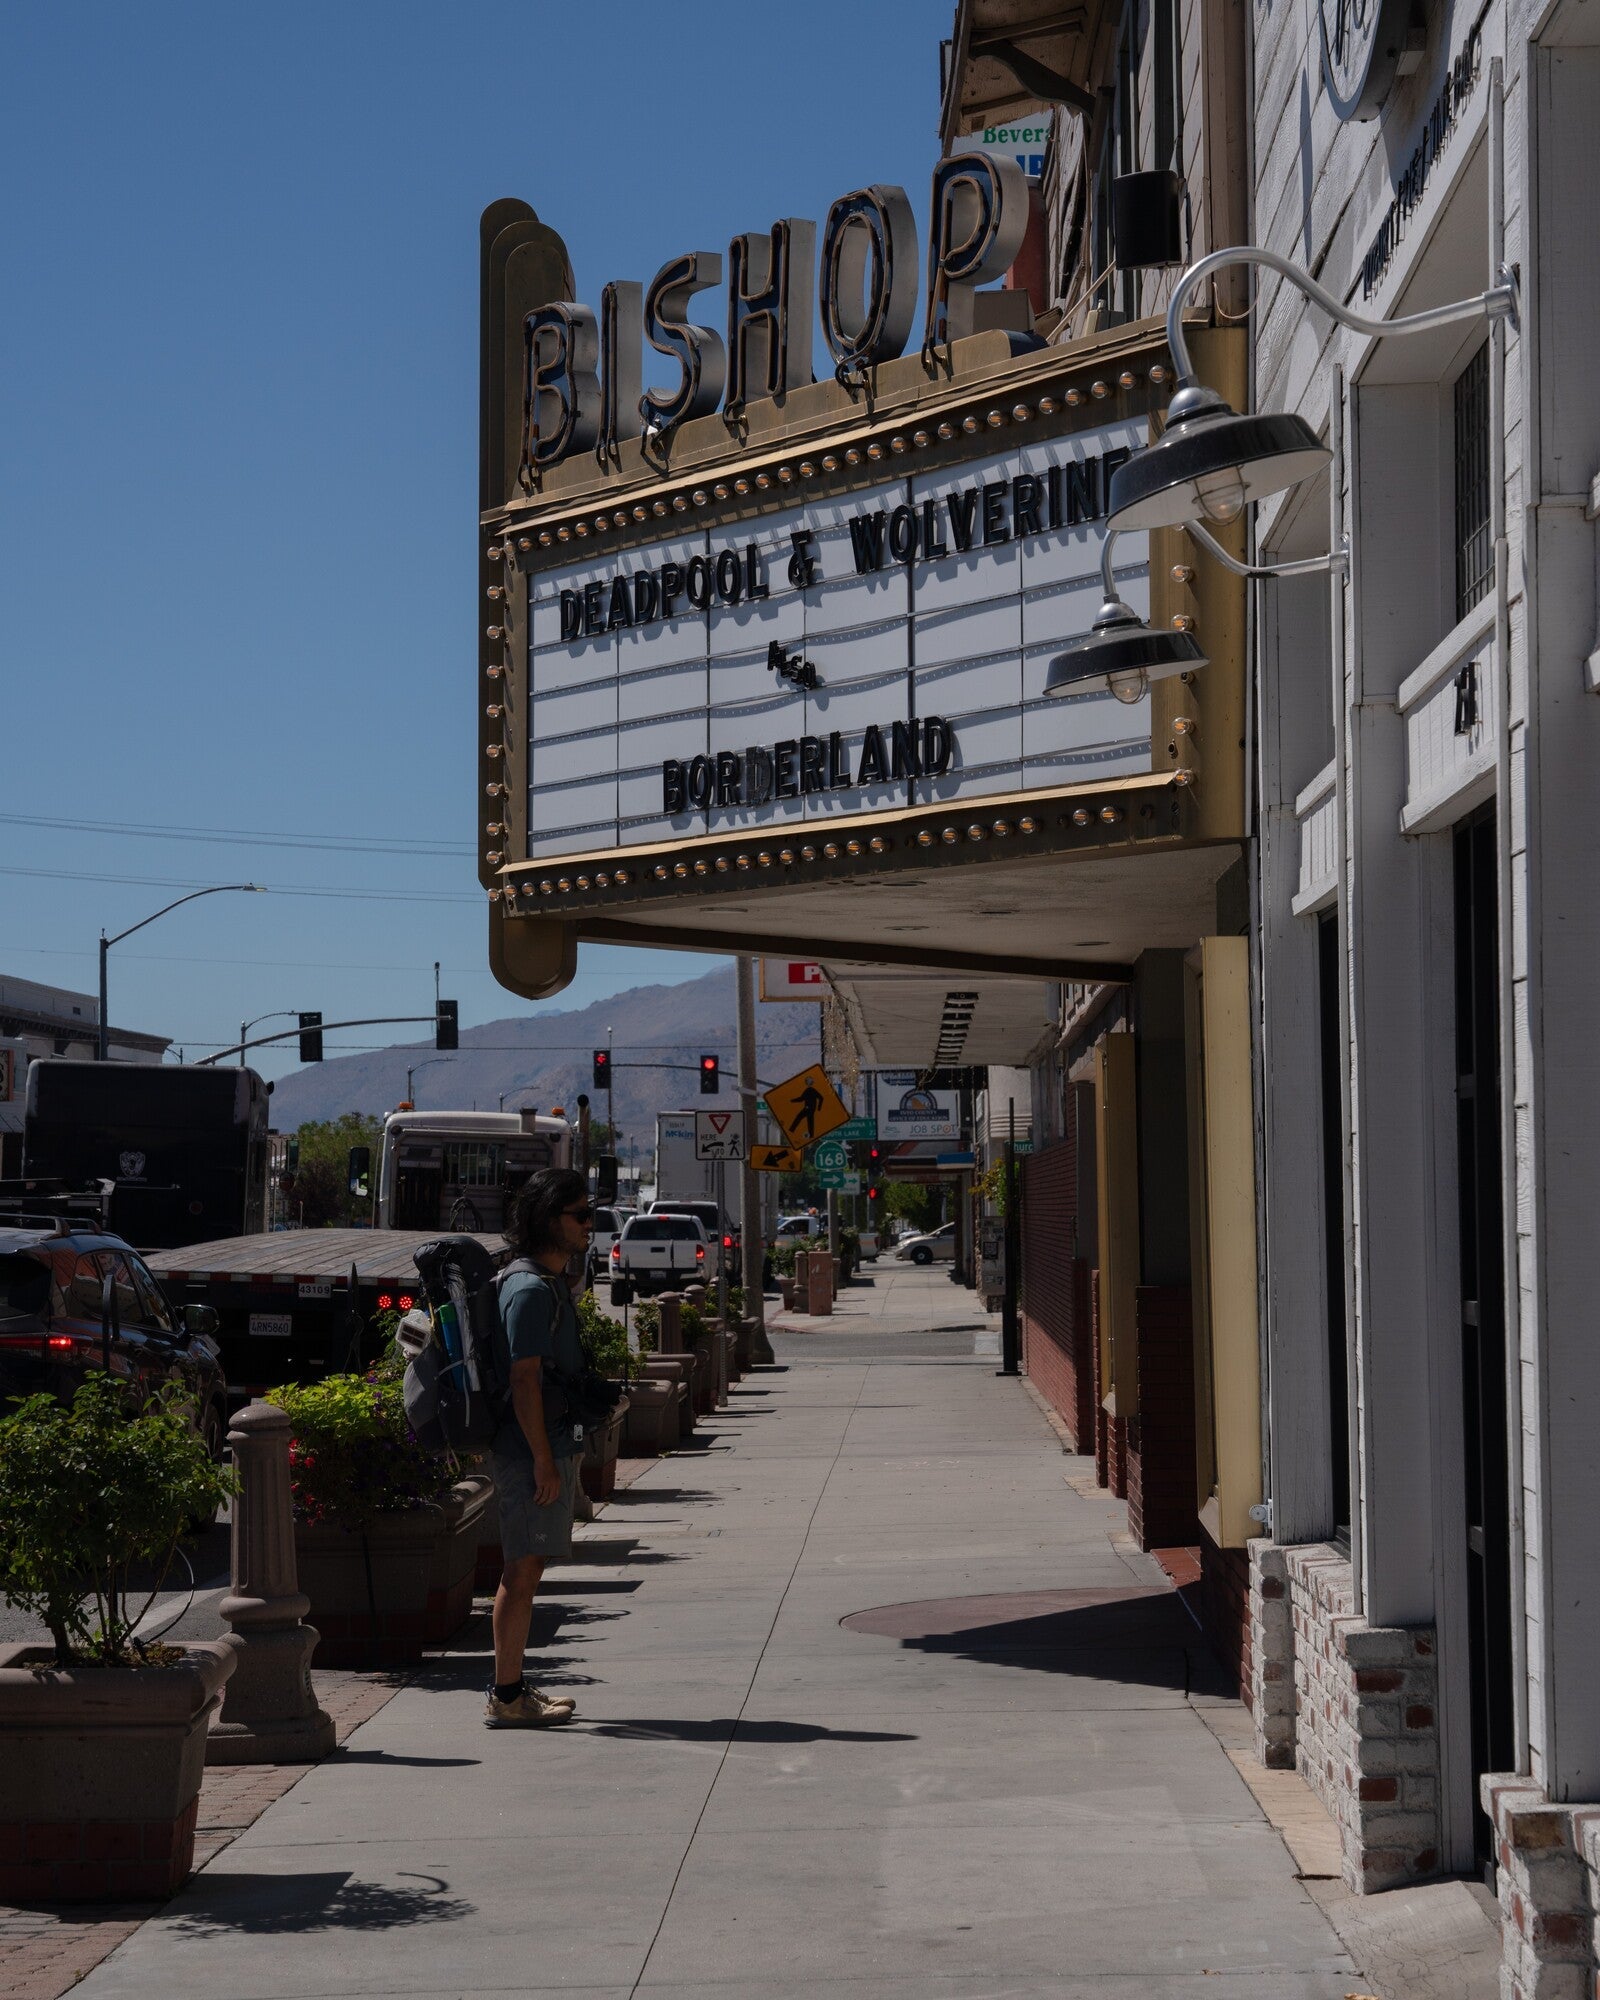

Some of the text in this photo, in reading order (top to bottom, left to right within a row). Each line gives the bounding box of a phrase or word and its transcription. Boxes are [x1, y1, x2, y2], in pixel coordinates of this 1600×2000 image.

[520, 152, 1028, 466] BISHOP
[560, 543, 769, 641] DEADPOOL
[787, 531, 814, 588] &
[767, 640, 816, 690] ALSO
[662, 716, 951, 814] BORDERLAND
[910, 1125, 928, 1134] JOB
[931, 1124, 956, 1134] SPOT
[701, 1133, 717, 1141] HERE
[818, 1152, 844, 1166] 168
[300, 1285, 330, 1295] 43109
[251, 1321, 289, 1333] 4RN5860
